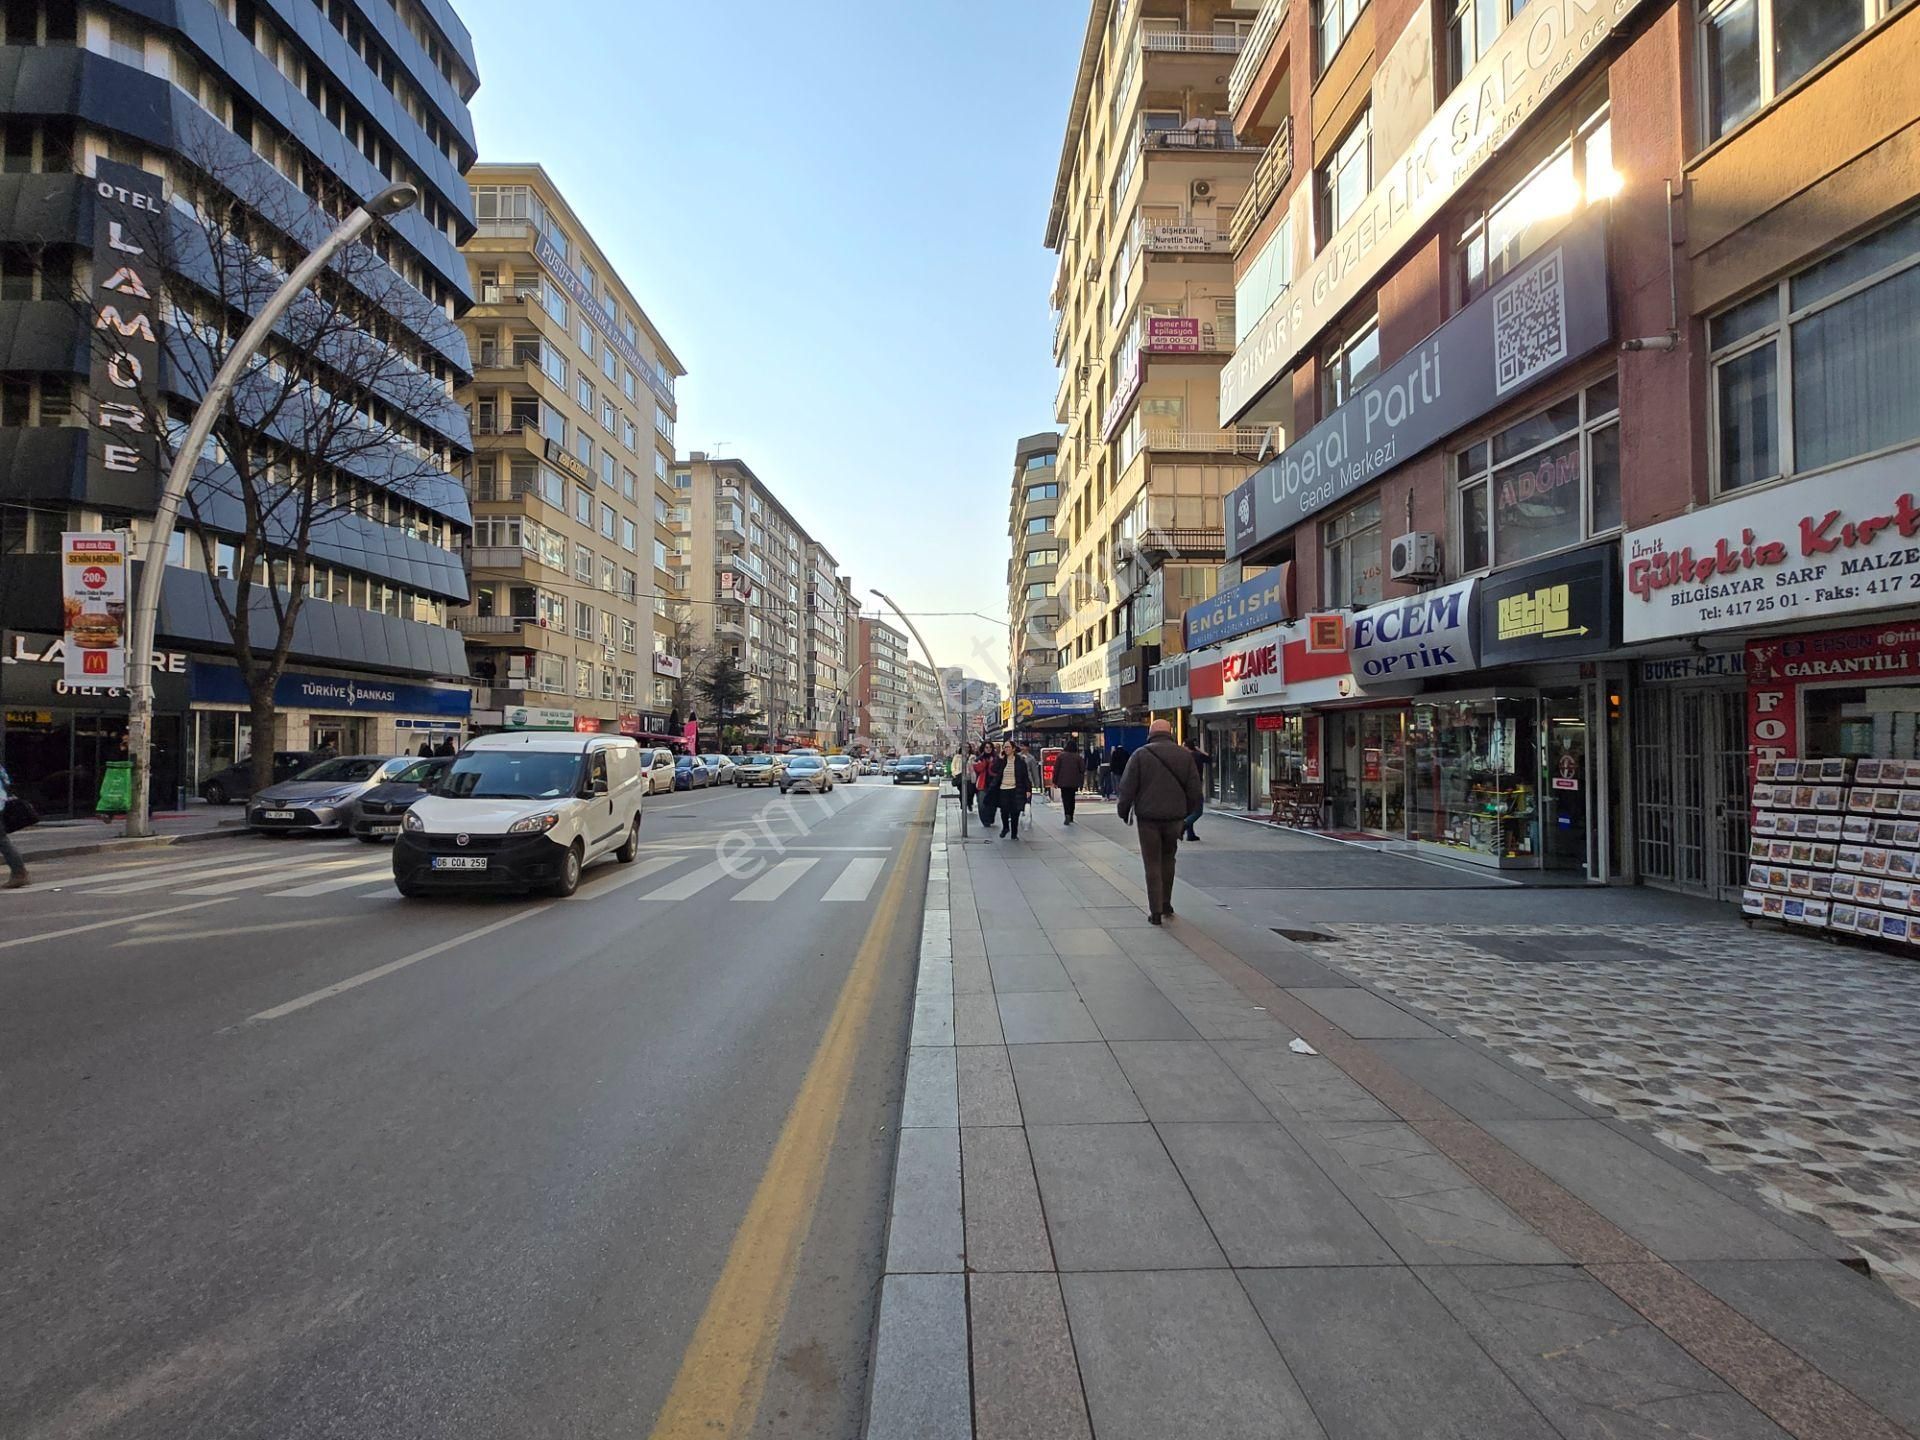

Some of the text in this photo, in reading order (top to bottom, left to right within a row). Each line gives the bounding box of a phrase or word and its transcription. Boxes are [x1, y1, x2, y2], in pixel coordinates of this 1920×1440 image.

[98, 182, 161, 214] OTEL
[1185, 236, 1204, 244] TUNA
[541, 242, 576, 292] PUSULA
[1180, 320, 1193, 328] life
[95, 221, 156, 472] LAMORE
[1271, 340, 1442, 505] Liberal Parti
[1299, 434, 1397, 512] Genel Merkezi
[1628, 527, 1789, 603] Gültekin
[1632, 538, 1663, 560] Ümit
[1670, 547, 1920, 607] BİLGİSAYAR SARF MALZE
[1189, 584, 1280, 635] ENGLISH
[1699, 607, 1722, 621] Tel:
[1726, 600, 1752, 617] 417
[1756, 596, 1775, 612] 25
[1779, 593, 1799, 609] 01
[1815, 585, 1860, 603] Faks:
[1866, 575, 1903, 595] 417
[1317, 621, 1338, 646] E
[1353, 590, 1465, 651] ECEM
[1222, 643, 1278, 683] ECZANE
[1363, 643, 1459, 677] OPTİK
[1644, 659, 1691, 681] BUKET
[1784, 649, 1909, 679] GARANTİLİ
[301, 682, 396, 702] TÜRKİYE BANKASI
[1241, 680, 1259, 696] ÜLKÜ
[436, 857, 447, 868] 06
[470, 856, 486, 868] 259
